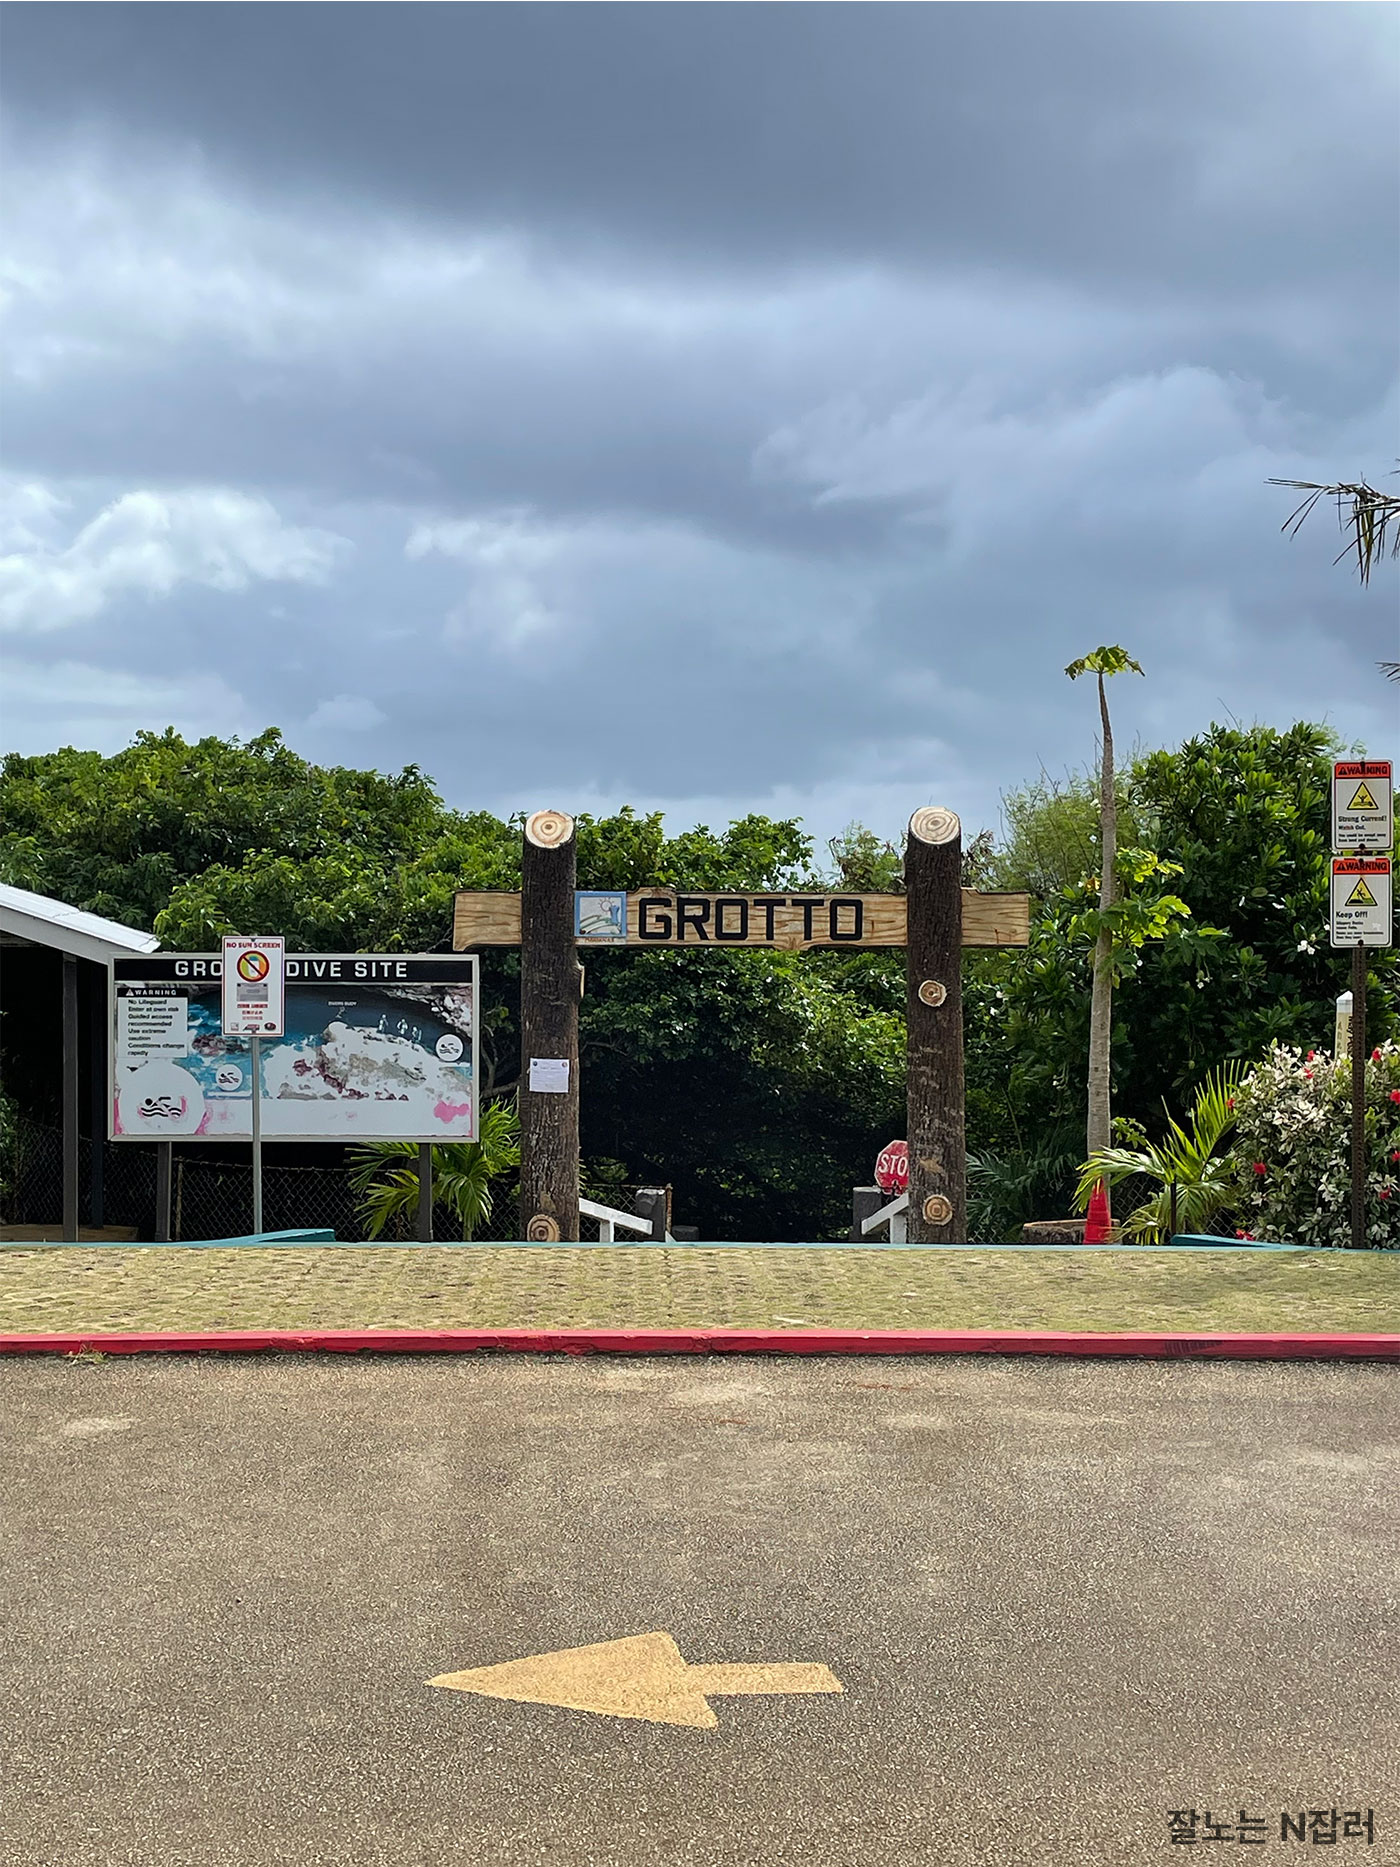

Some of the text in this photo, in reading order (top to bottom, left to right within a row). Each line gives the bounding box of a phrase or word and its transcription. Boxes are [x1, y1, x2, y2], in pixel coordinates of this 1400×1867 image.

[1338, 815, 1359, 823] Strong
[1345, 862, 1387, 871] WARNING
[638, 898, 864, 941] GROTTO
[1336, 911, 1353, 919] Keep
[175, 961, 407, 977] GRO DIVE SITE
[878, 1153, 908, 1177] STO
